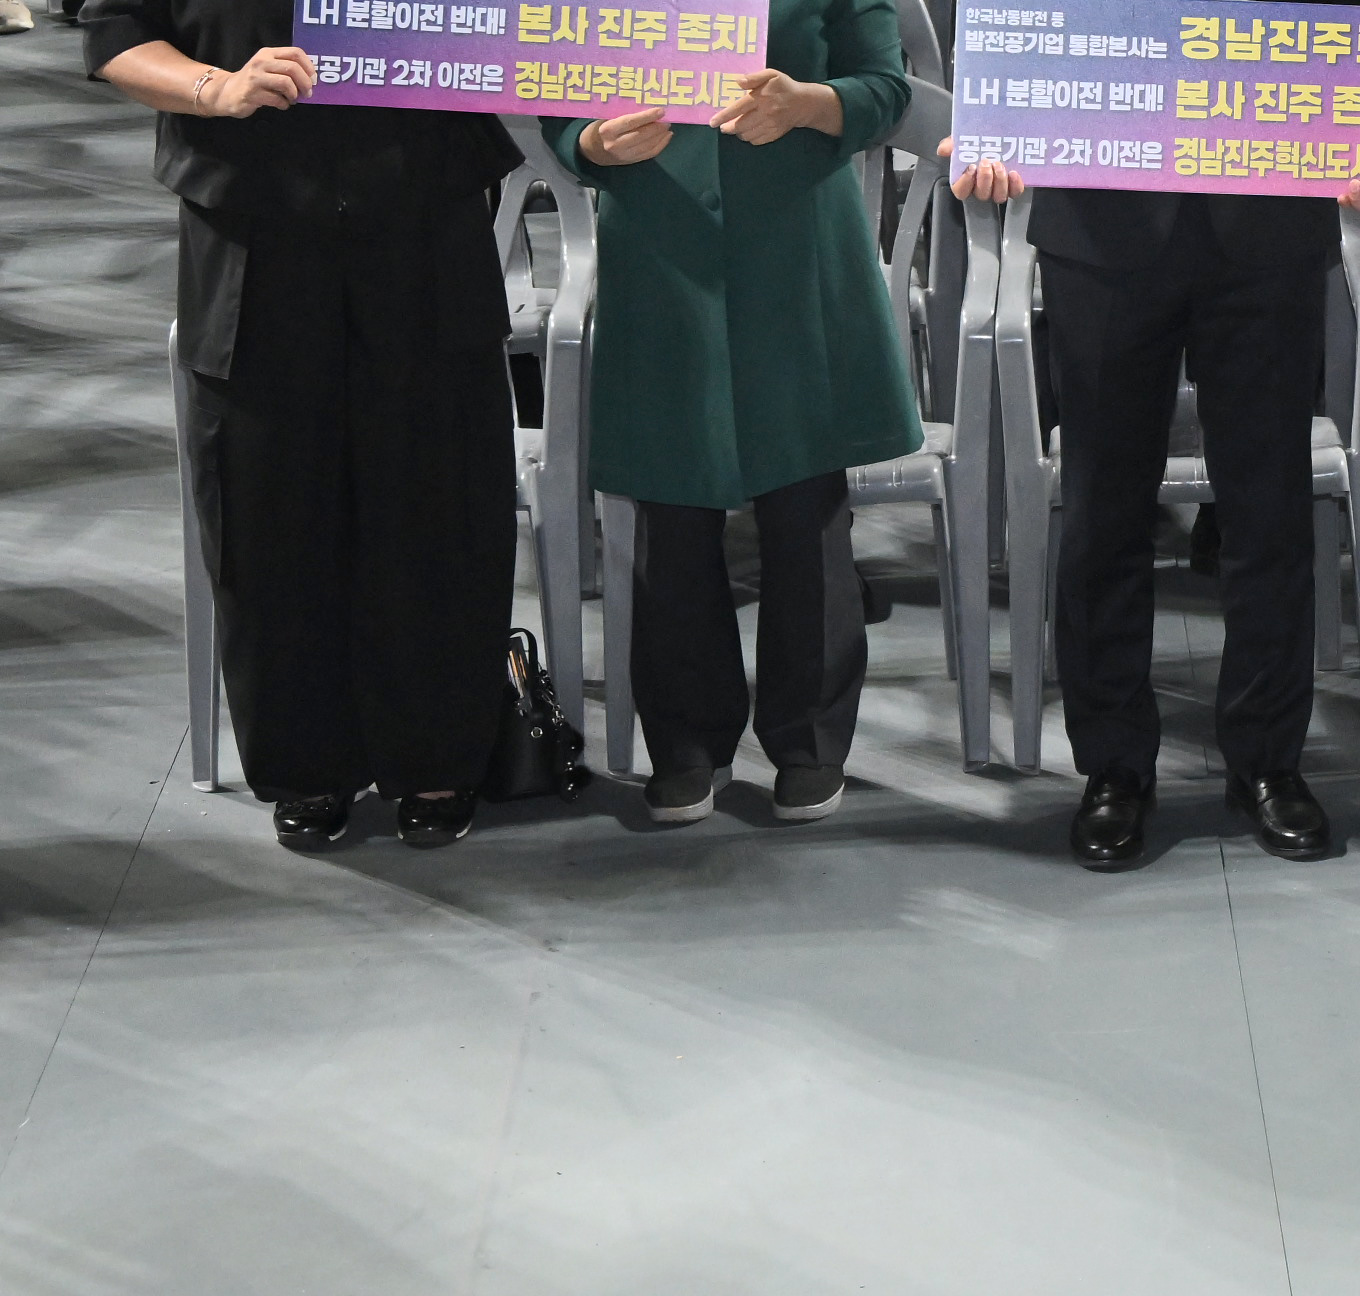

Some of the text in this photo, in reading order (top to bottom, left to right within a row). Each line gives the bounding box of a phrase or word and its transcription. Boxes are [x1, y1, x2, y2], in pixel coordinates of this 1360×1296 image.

[346, 0, 444, 32] 분할이전
[450, 6, 505, 35] 반대!
[517, 4, 589, 45] 본사
[598, 9, 666, 49] 진주
[677, 13, 757, 53] 존치!
[966, 8, 1065, 27] 한국남동발전 등
[965, 30, 1064, 54] 발전공기업
[1069, 34, 1167, 59] 통합본사는
[392, 59, 503, 92] 2차 이전은
[964, 79, 999, 105] LH
[1006, 79, 1102, 111] 분할이전
[1109, 83, 1163, 112] 반대!
[1175, 80, 1246, 119] 본사
[1255, 83, 1322, 124] 진주
[958, 135, 1047, 165] 공공기관
[1052, 139, 1092, 166] 2차
[1098, 140, 1162, 169] 이전은
